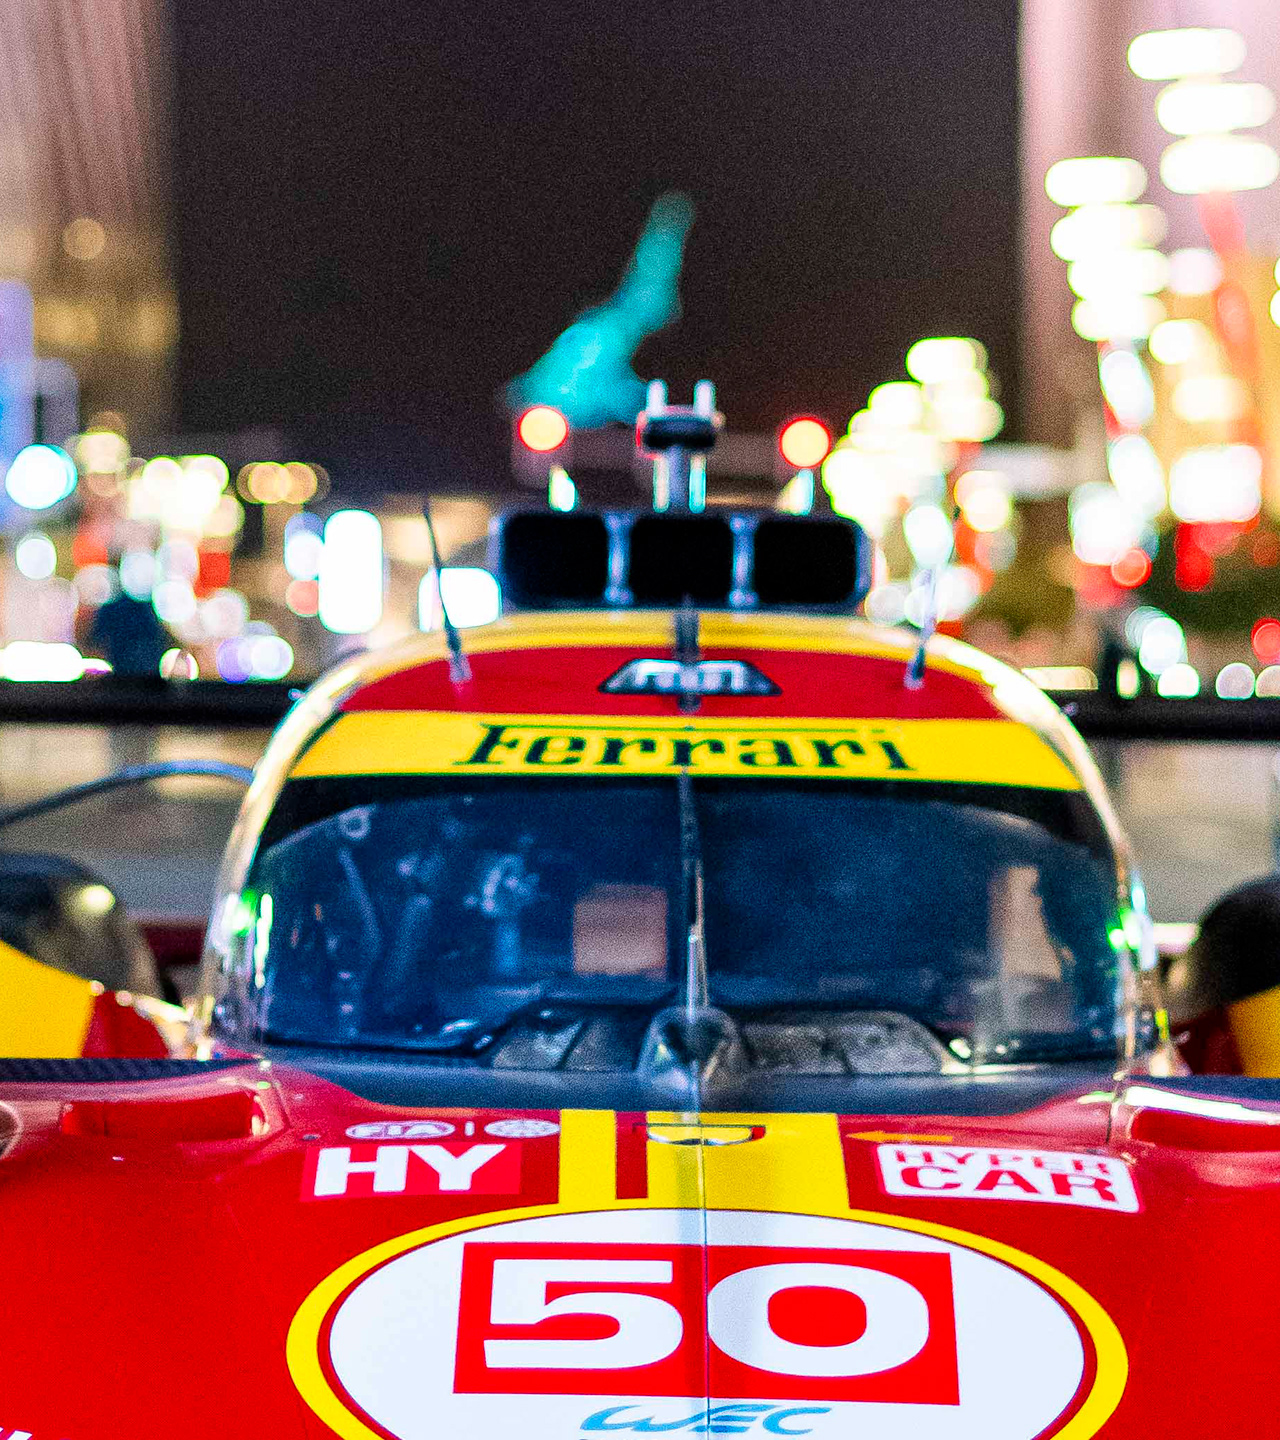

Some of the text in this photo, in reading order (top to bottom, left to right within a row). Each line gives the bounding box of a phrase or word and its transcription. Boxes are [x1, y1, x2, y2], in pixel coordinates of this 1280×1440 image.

[453, 723, 918, 772] Ferrari
[313, 1143, 508, 1197] HY
[892, 1148, 1112, 1175] HYPER
[899, 1164, 1118, 1204] CAR
[483, 1258, 930, 1378] 50
[579, 1403, 833, 1436] WEC
